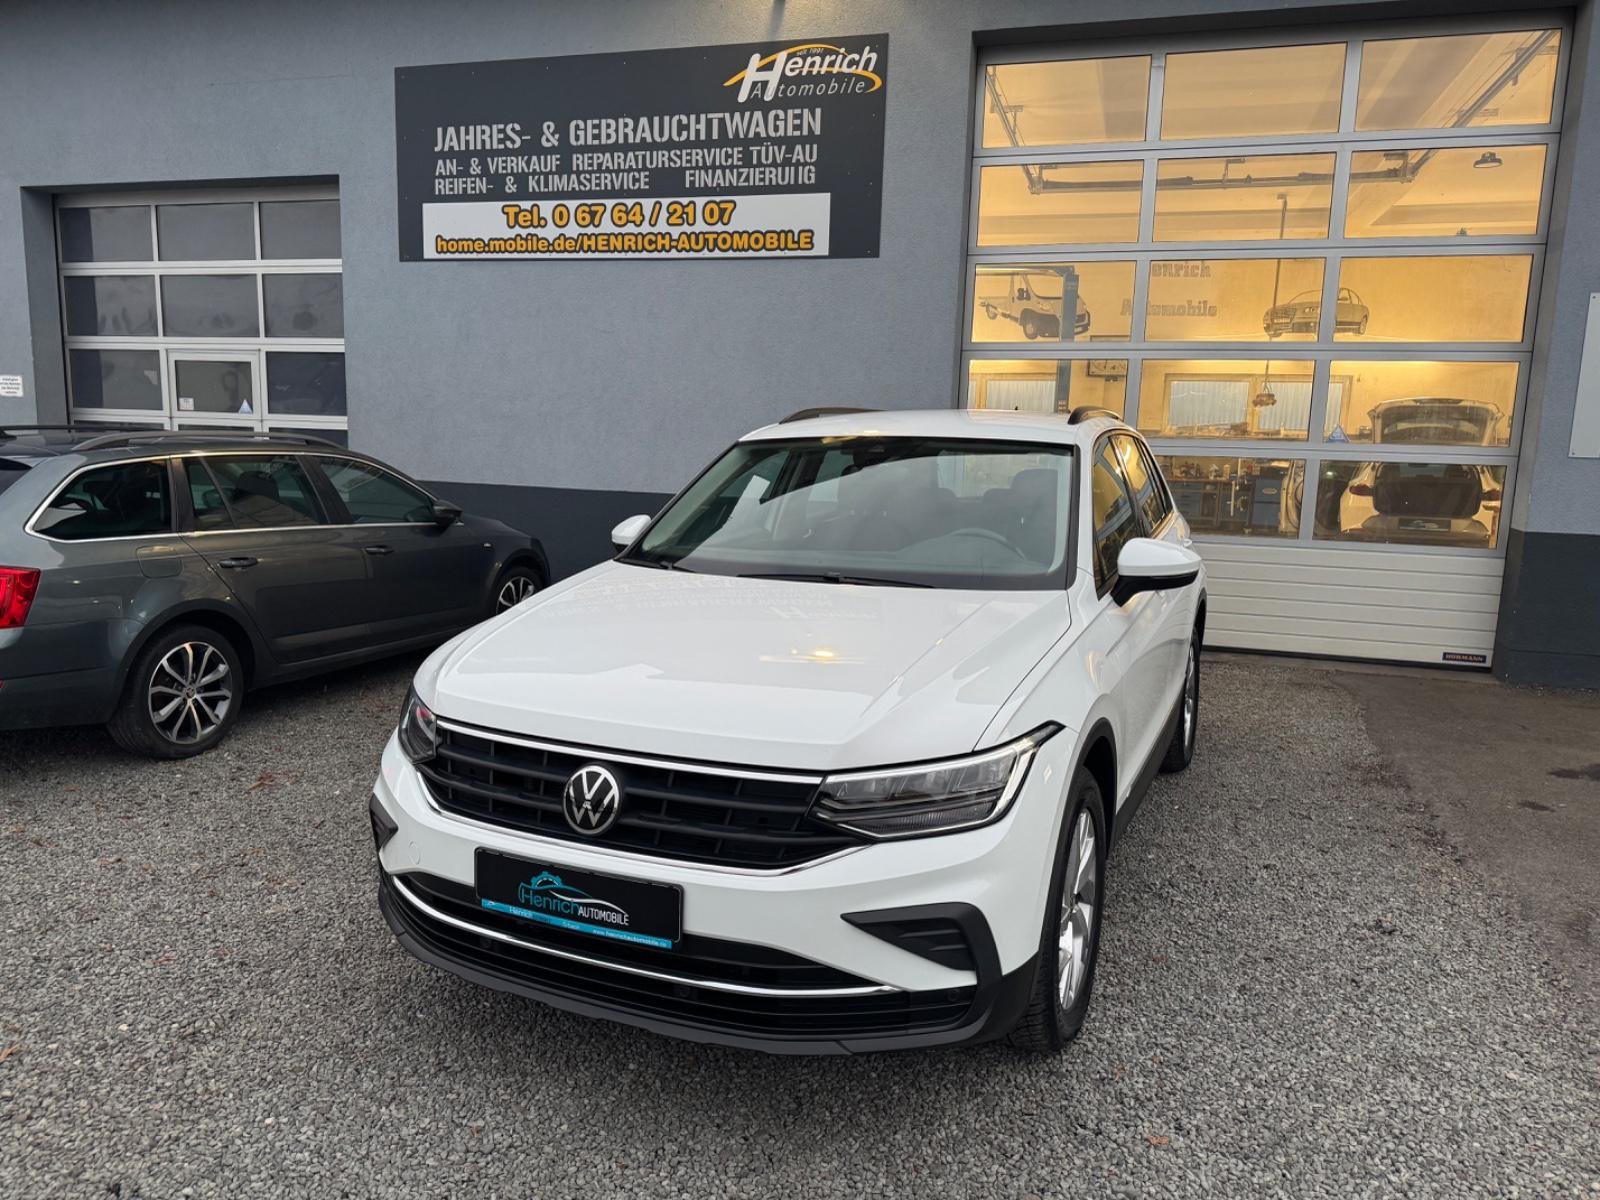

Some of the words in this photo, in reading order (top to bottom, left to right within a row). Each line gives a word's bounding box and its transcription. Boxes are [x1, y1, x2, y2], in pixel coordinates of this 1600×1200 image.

[737, 45, 878, 103] Henrich
[750, 76, 866, 99] Atomobile
[434, 123, 531, 152] JAHRES-
[540, 121, 560, 148] &
[568, 107, 822, 146] GEBRAUCHTWAGEN
[435, 158, 464, 177] AN-
[469, 157, 482, 175] &
[487, 154, 561, 174] VERKAUF
[571, 147, 743, 172] REPARATURSERVICE
[748, 142, 818, 165] TÜV-AU
[434, 177, 494, 196] REIFEN-
[504, 175, 517, 194] &
[528, 171, 650, 193] KLIMASERVICE
[501, 203, 548, 229] Tel.
[552, 203, 571, 229] 0
[574, 202, 607, 229] 67
[611, 201, 645, 228] 64
[648, 200, 663, 227] /
[666, 200, 697, 226] 21
[702, 199, 738, 226] 07
[436, 229, 815, 254] home.mobile.de/HENRICH-AUTOMOBILE
[1150, 260, 1211, 278] enrich
[518, 881, 580, 915] Henrich
[578, 905, 630, 926] AUTOMOBILE
